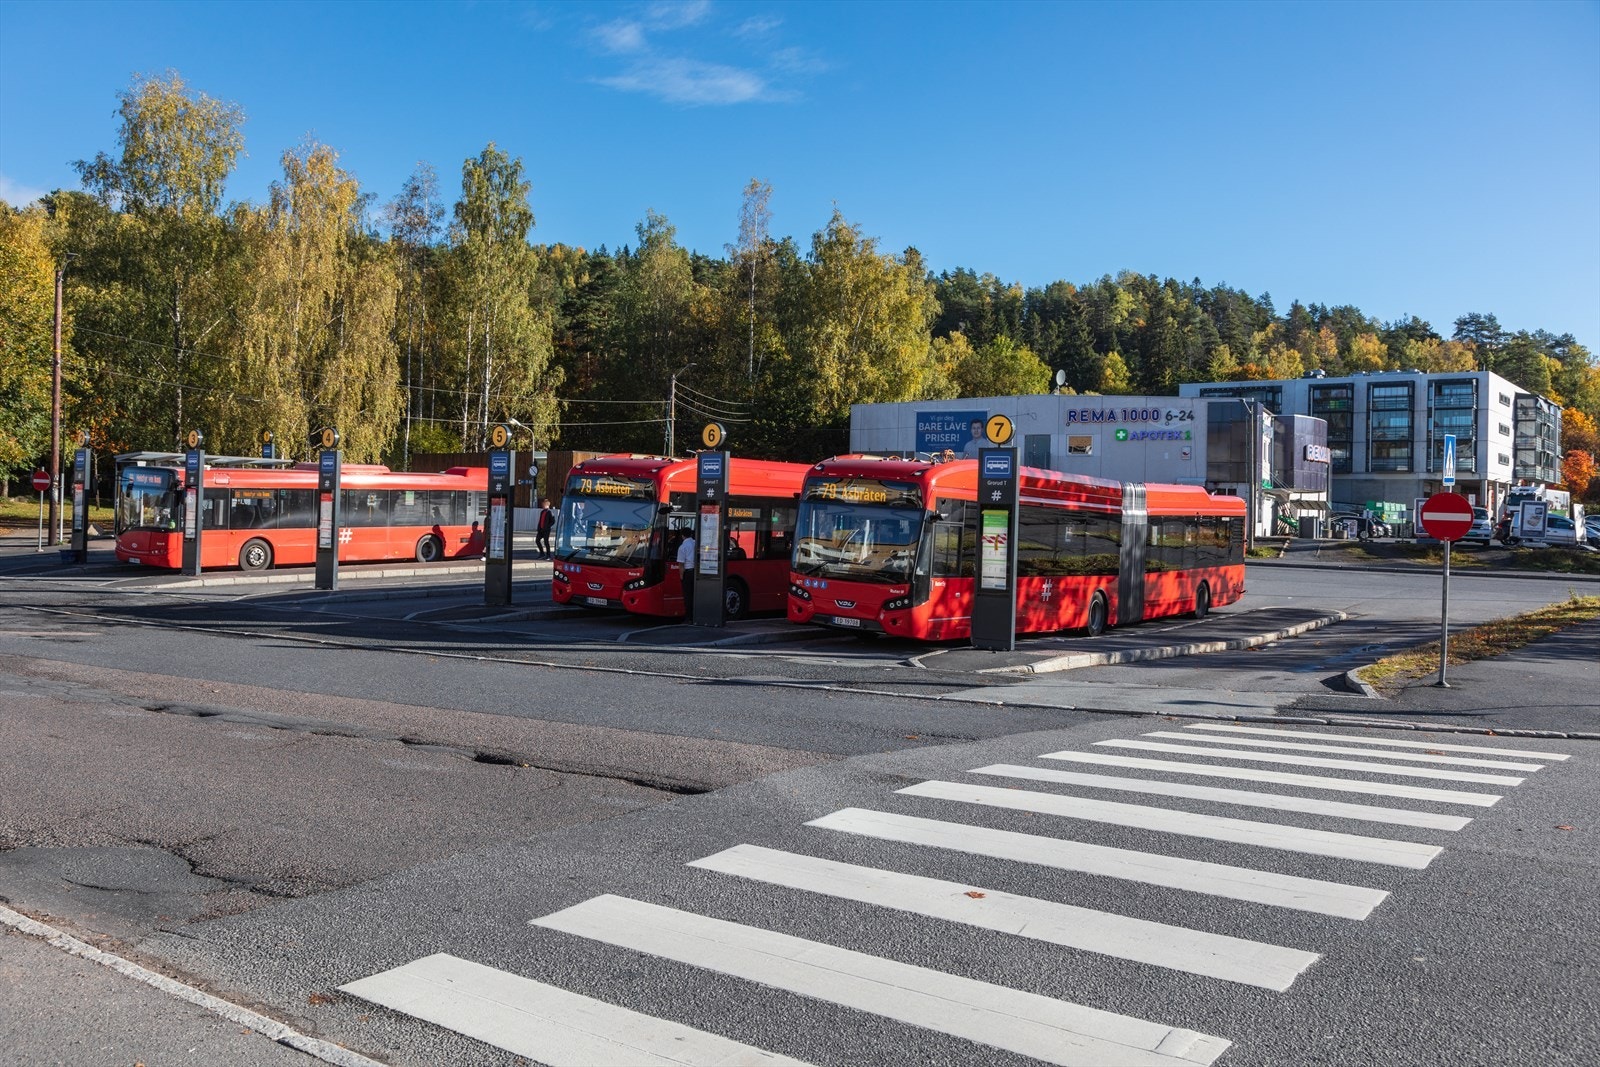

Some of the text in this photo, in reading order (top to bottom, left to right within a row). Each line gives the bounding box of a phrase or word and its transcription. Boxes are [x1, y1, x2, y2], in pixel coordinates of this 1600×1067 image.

[1067, 408, 1195, 422] REMA 1000 6-24
[919, 422, 967, 430] BARE LAVE
[994, 423, 1005, 437] 7
[79, 432, 84, 443] 2
[190, 432, 196, 443] 3
[326, 433, 331, 443] 4
[497, 431, 503, 442] 5
[708, 429, 715, 442] 6
[925, 433, 960, 442] PRISER!
[1129, 430, 1192, 441] APOTEK 1
[581, 479, 592, 493] 79
[822, 483, 837, 499] 79
